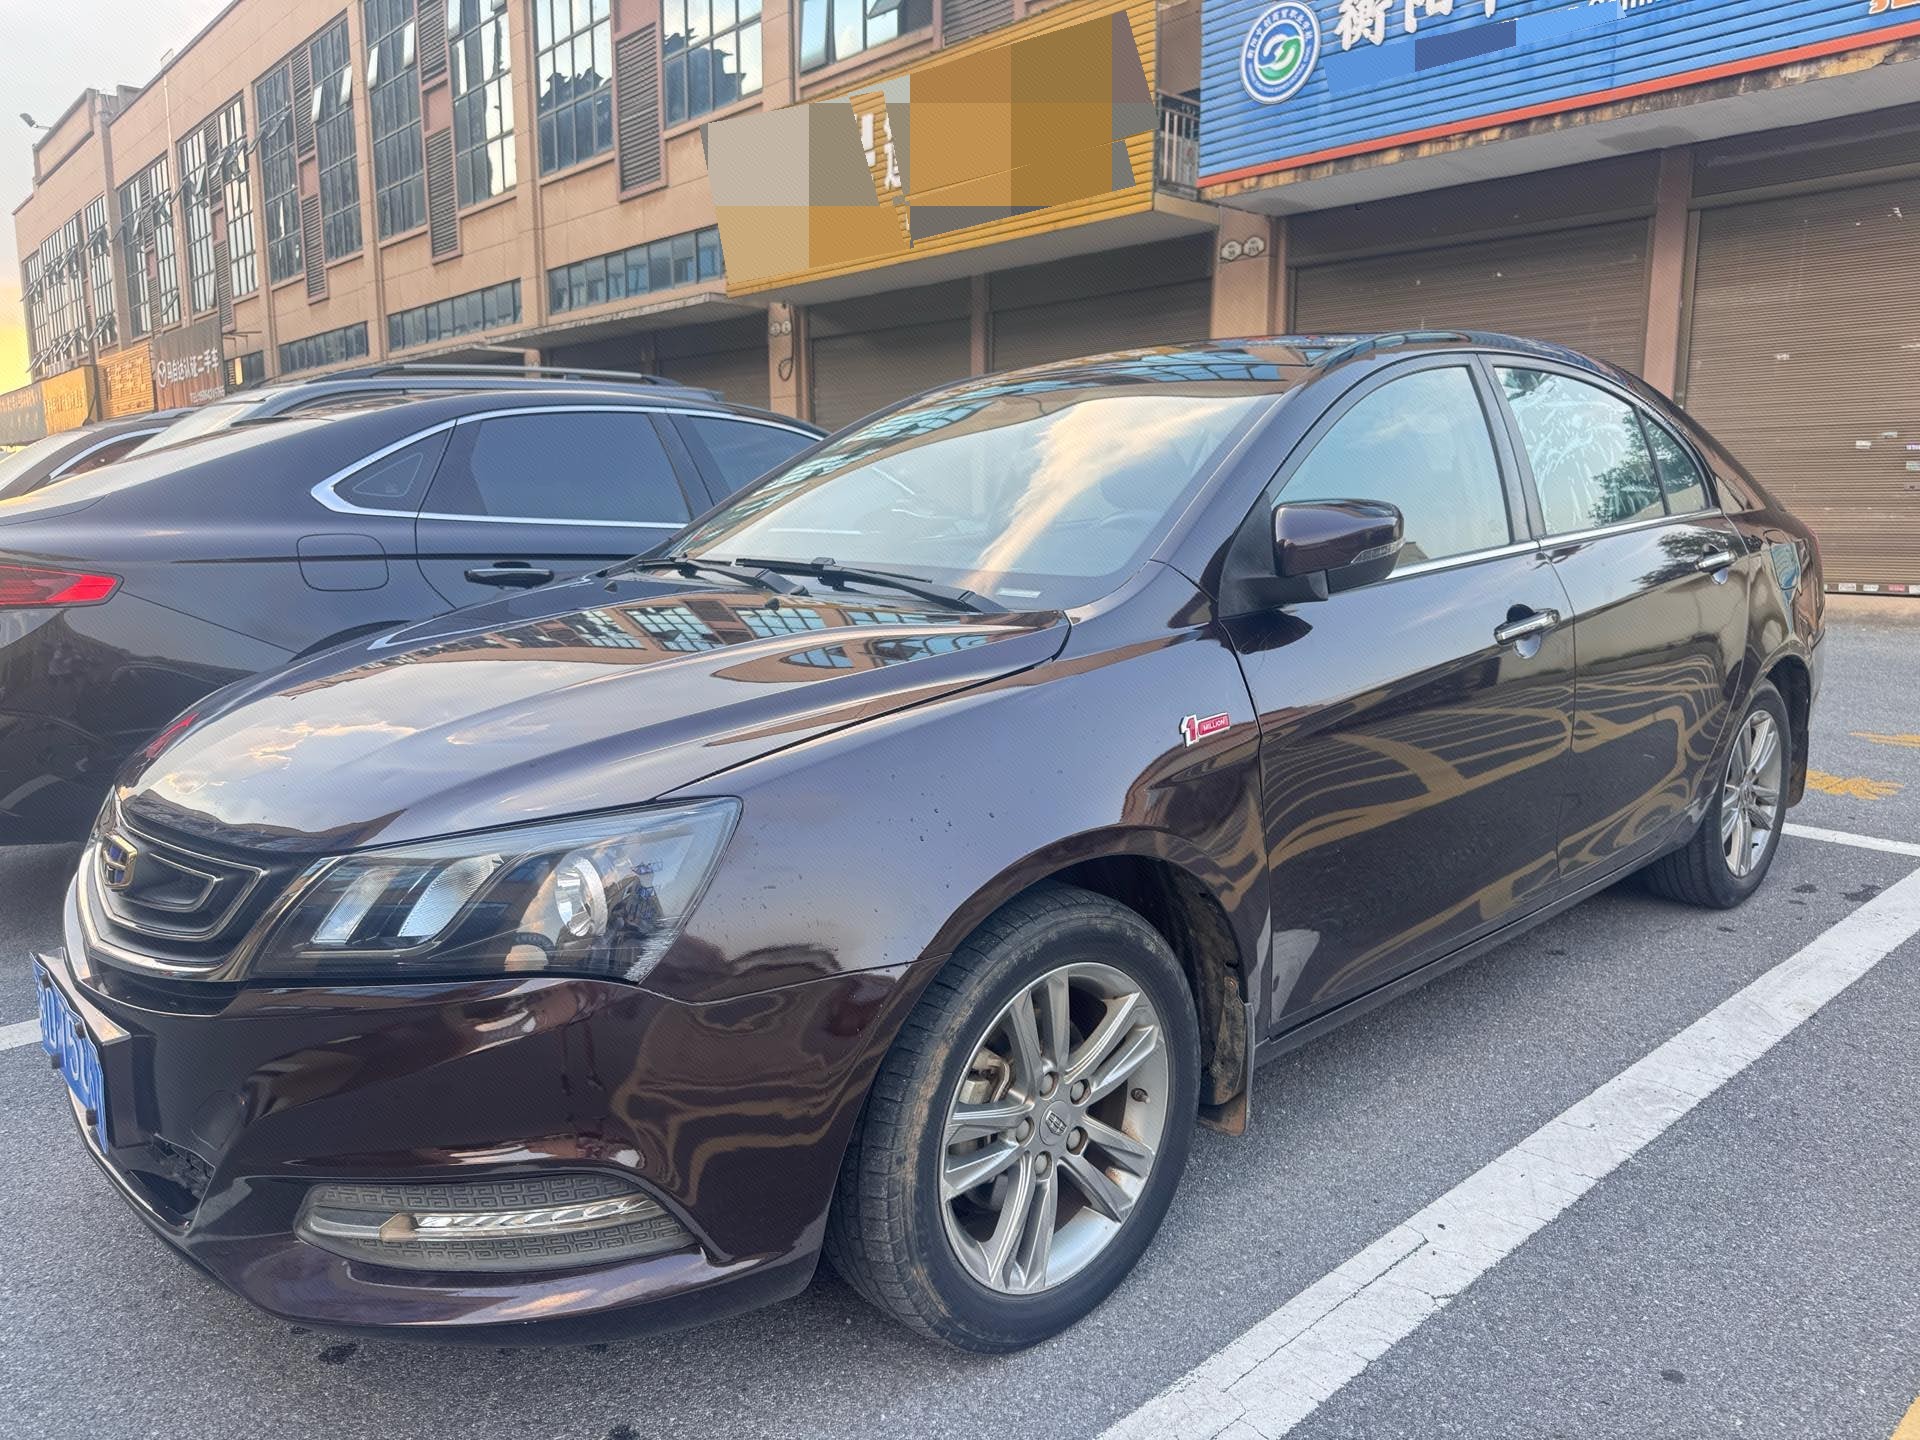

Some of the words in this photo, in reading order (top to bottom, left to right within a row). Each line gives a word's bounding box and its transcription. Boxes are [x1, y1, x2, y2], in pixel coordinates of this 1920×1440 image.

[1334, 0, 1497, 51] 衡阳
[1183, 715, 1198, 744] 1
[1202, 718, 1226, 731] MILLION
